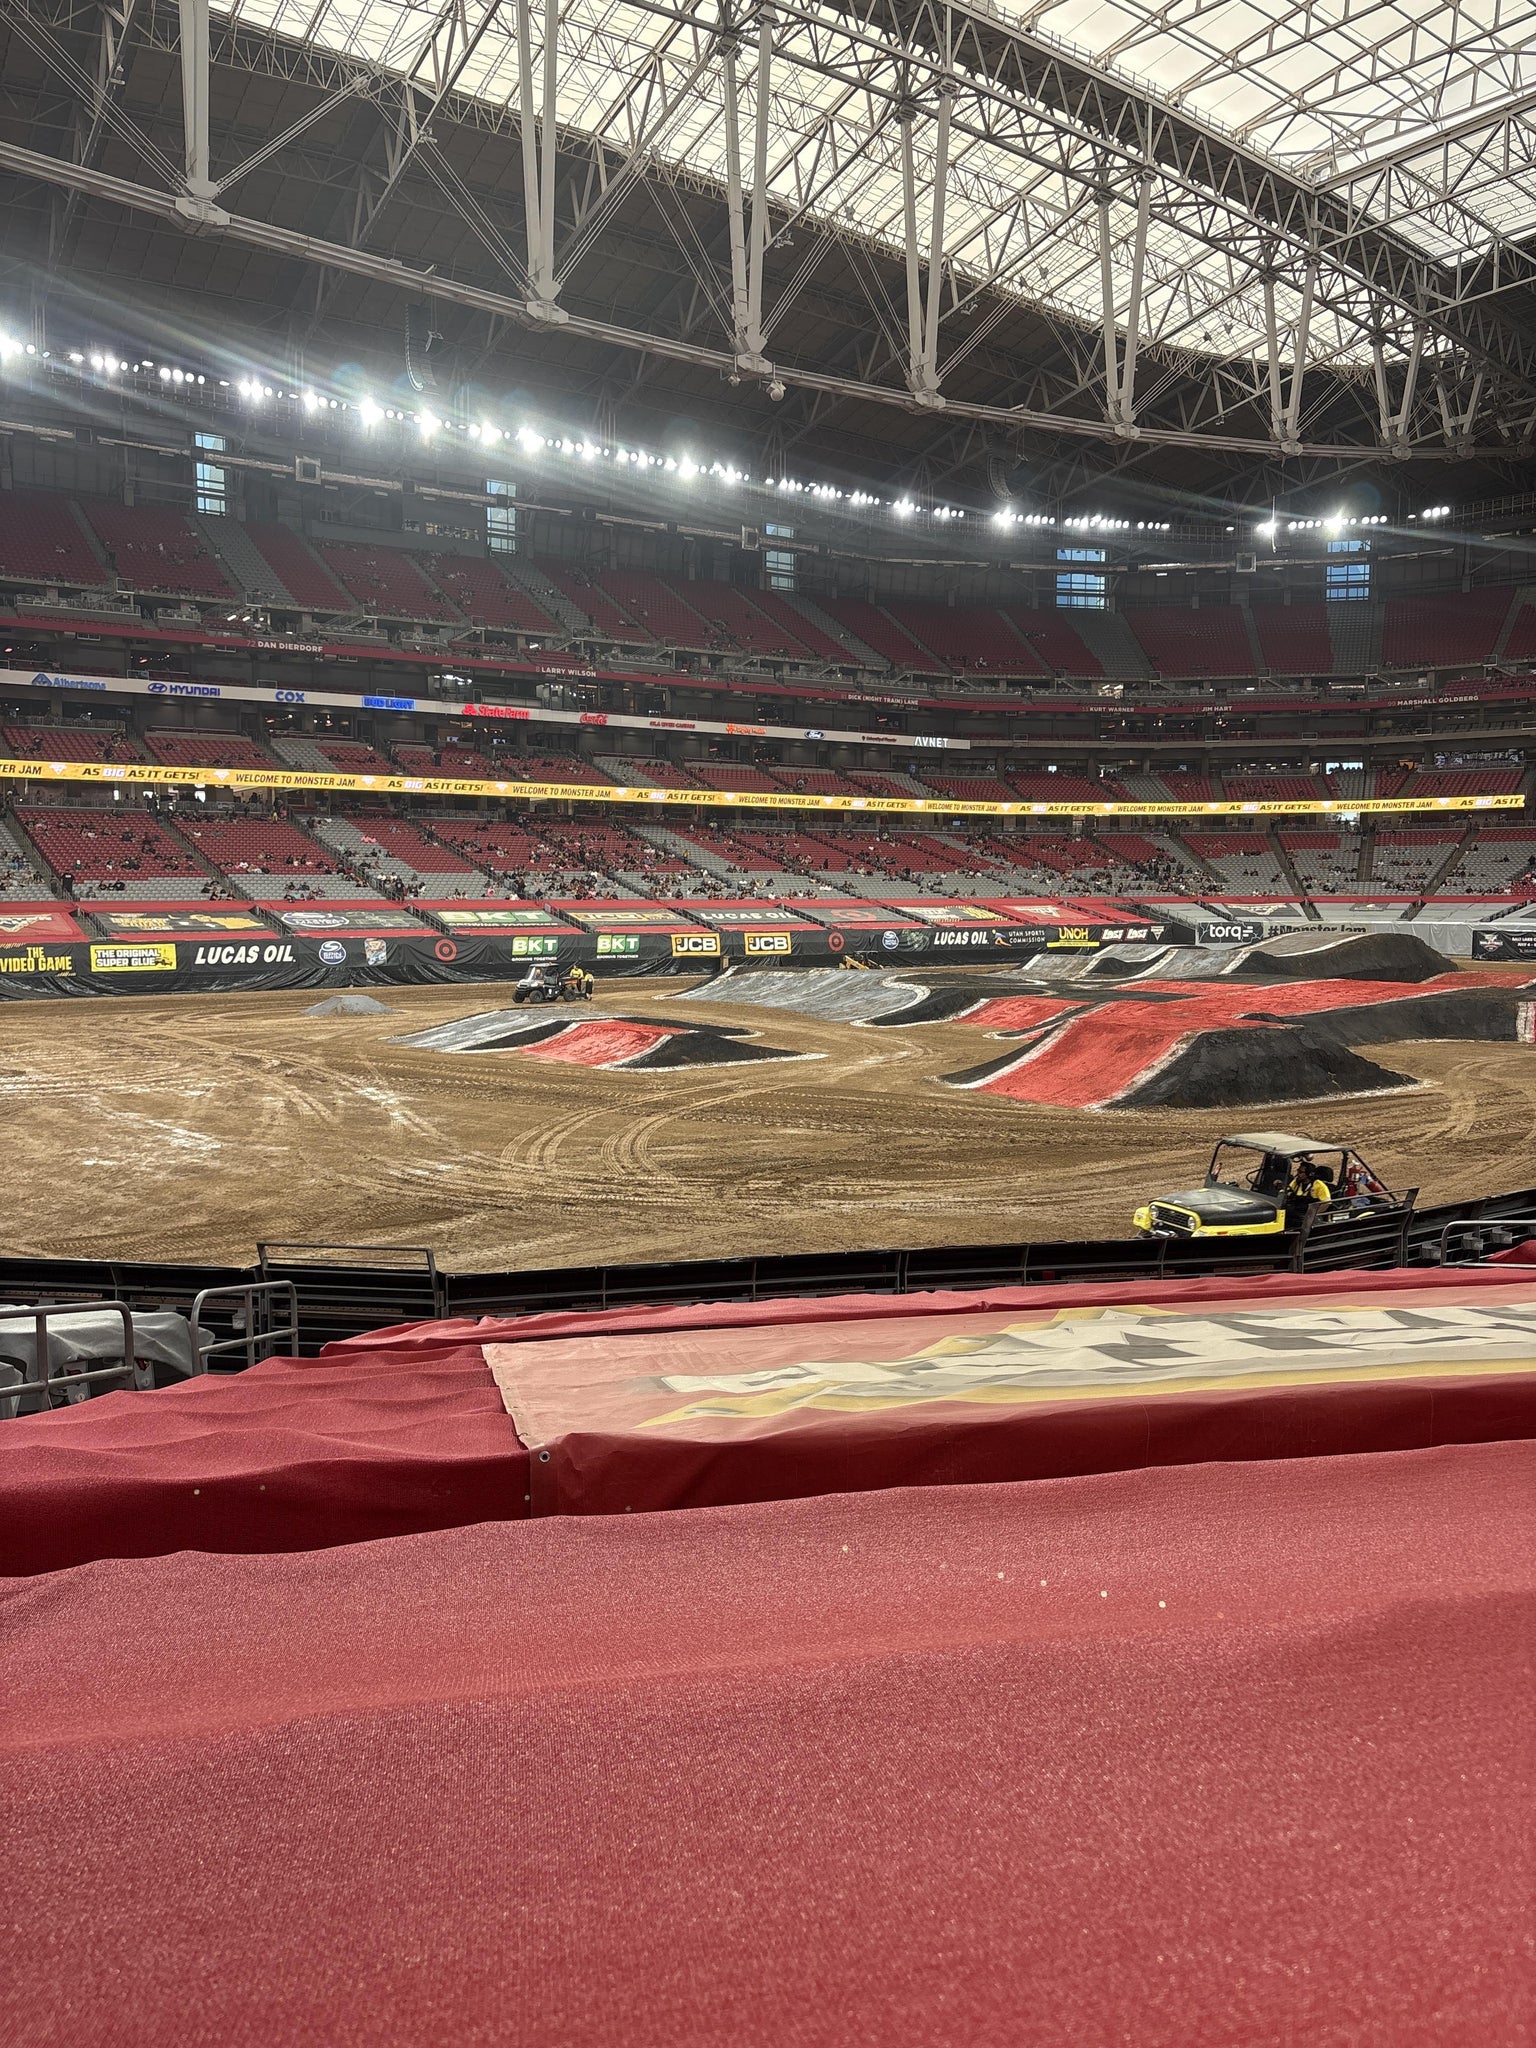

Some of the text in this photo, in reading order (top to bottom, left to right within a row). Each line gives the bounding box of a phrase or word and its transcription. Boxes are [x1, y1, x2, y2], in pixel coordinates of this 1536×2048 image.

[257, 641, 277, 649] DAN
[278, 642, 324, 653] DIERDORF
[541, 666, 566, 675] LARRY
[566, 668, 597, 678] WILSON
[53, 677, 107, 691] Albertsons
[169, 684, 221, 697] HYUNDAI
[275, 690, 305, 703] COX
[1397, 698, 1438, 707] MARSHALL
[1438, 695, 1479, 704] GOLDBERG
[914, 736, 949, 749] AVNET
[18, 765, 43, 776] JAM
[82, 767, 200, 780] AS BIG AS IT GETS!
[235, 773, 356, 787] WELCOME TO MONSTER JAM
[387, 780, 484, 792] AS BIG AS IT GETS!
[512, 785, 611, 798] WELCOME TO MONSTER JAM
[636, 791, 649, 799] AS
[666, 792, 679, 800] AS
[679, 793, 690, 801] IT
[690, 793, 715, 802] GETS!
[738, 795, 820, 807] WELCOME TO MONSTER JAM
[866, 800, 877, 808] AS
[885, 801, 907, 809] GETS!
[927, 802, 953, 811] WELCOME
[953, 803, 961, 811] TO
[960, 804, 986, 812] MONSTER
[1336, 801, 1433, 810] WELCOME TO MONSTER JAM
[1460, 799, 1474, 807] AS
[1493, 798, 1508, 806] AS
[1070, 805, 1095, 813] GETS!
[1117, 805, 1204, 813] WELCOME TO MONSTER JAM
[1228, 804, 1242, 812] AS
[1259, 804, 1273, 812] AS
[1284, 803, 1311, 811] GETS!
[700, 911, 799, 920] LUCAS OIL
[933, 931, 970, 945] LUCAS
[1024, 929, 1046, 937] SPORTS
[1058, 927, 1089, 940] UNOH
[513, 938, 557, 953] BKT
[598, 937, 639, 951] BKT
[676, 937, 717, 952] JCB
[749, 936, 788, 951] JCB
[1009, 936, 1046, 944] COMMISSION
[26, 946, 44, 959] THE
[95, 948, 161, 958] THE ORIGINAL
[194, 945, 259, 965] LUCAS
[0, 955, 73, 973] VIDEO GAME
[96, 957, 156, 967] SUPER GLUE
